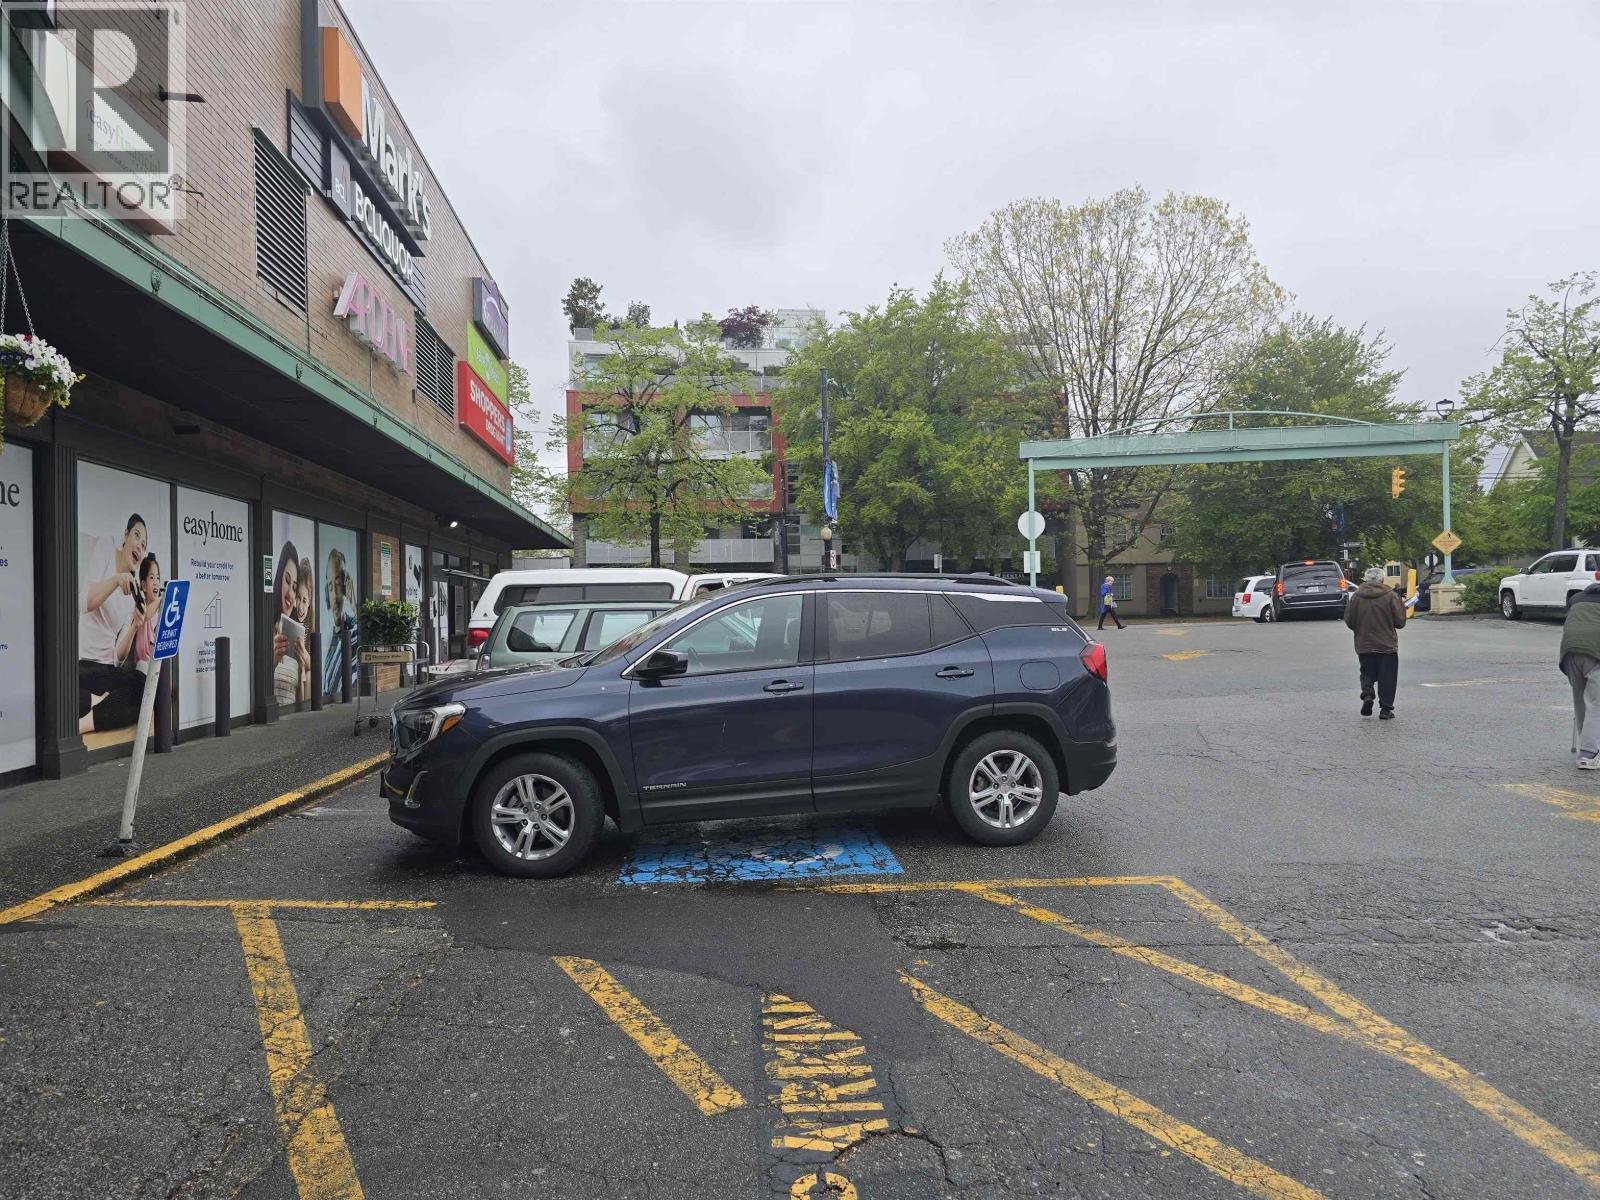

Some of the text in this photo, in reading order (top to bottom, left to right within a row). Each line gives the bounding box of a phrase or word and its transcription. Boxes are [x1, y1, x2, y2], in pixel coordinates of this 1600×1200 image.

[361, 73, 432, 241] Mark's
[470, 379, 505, 433] SHOPPERS
[183, 510, 243, 546] easyhome
[156, 640, 178, 652] REQUIRED
[161, 629, 178, 640] PERMIT
[642, 782, 687, 791] TERRAIN
